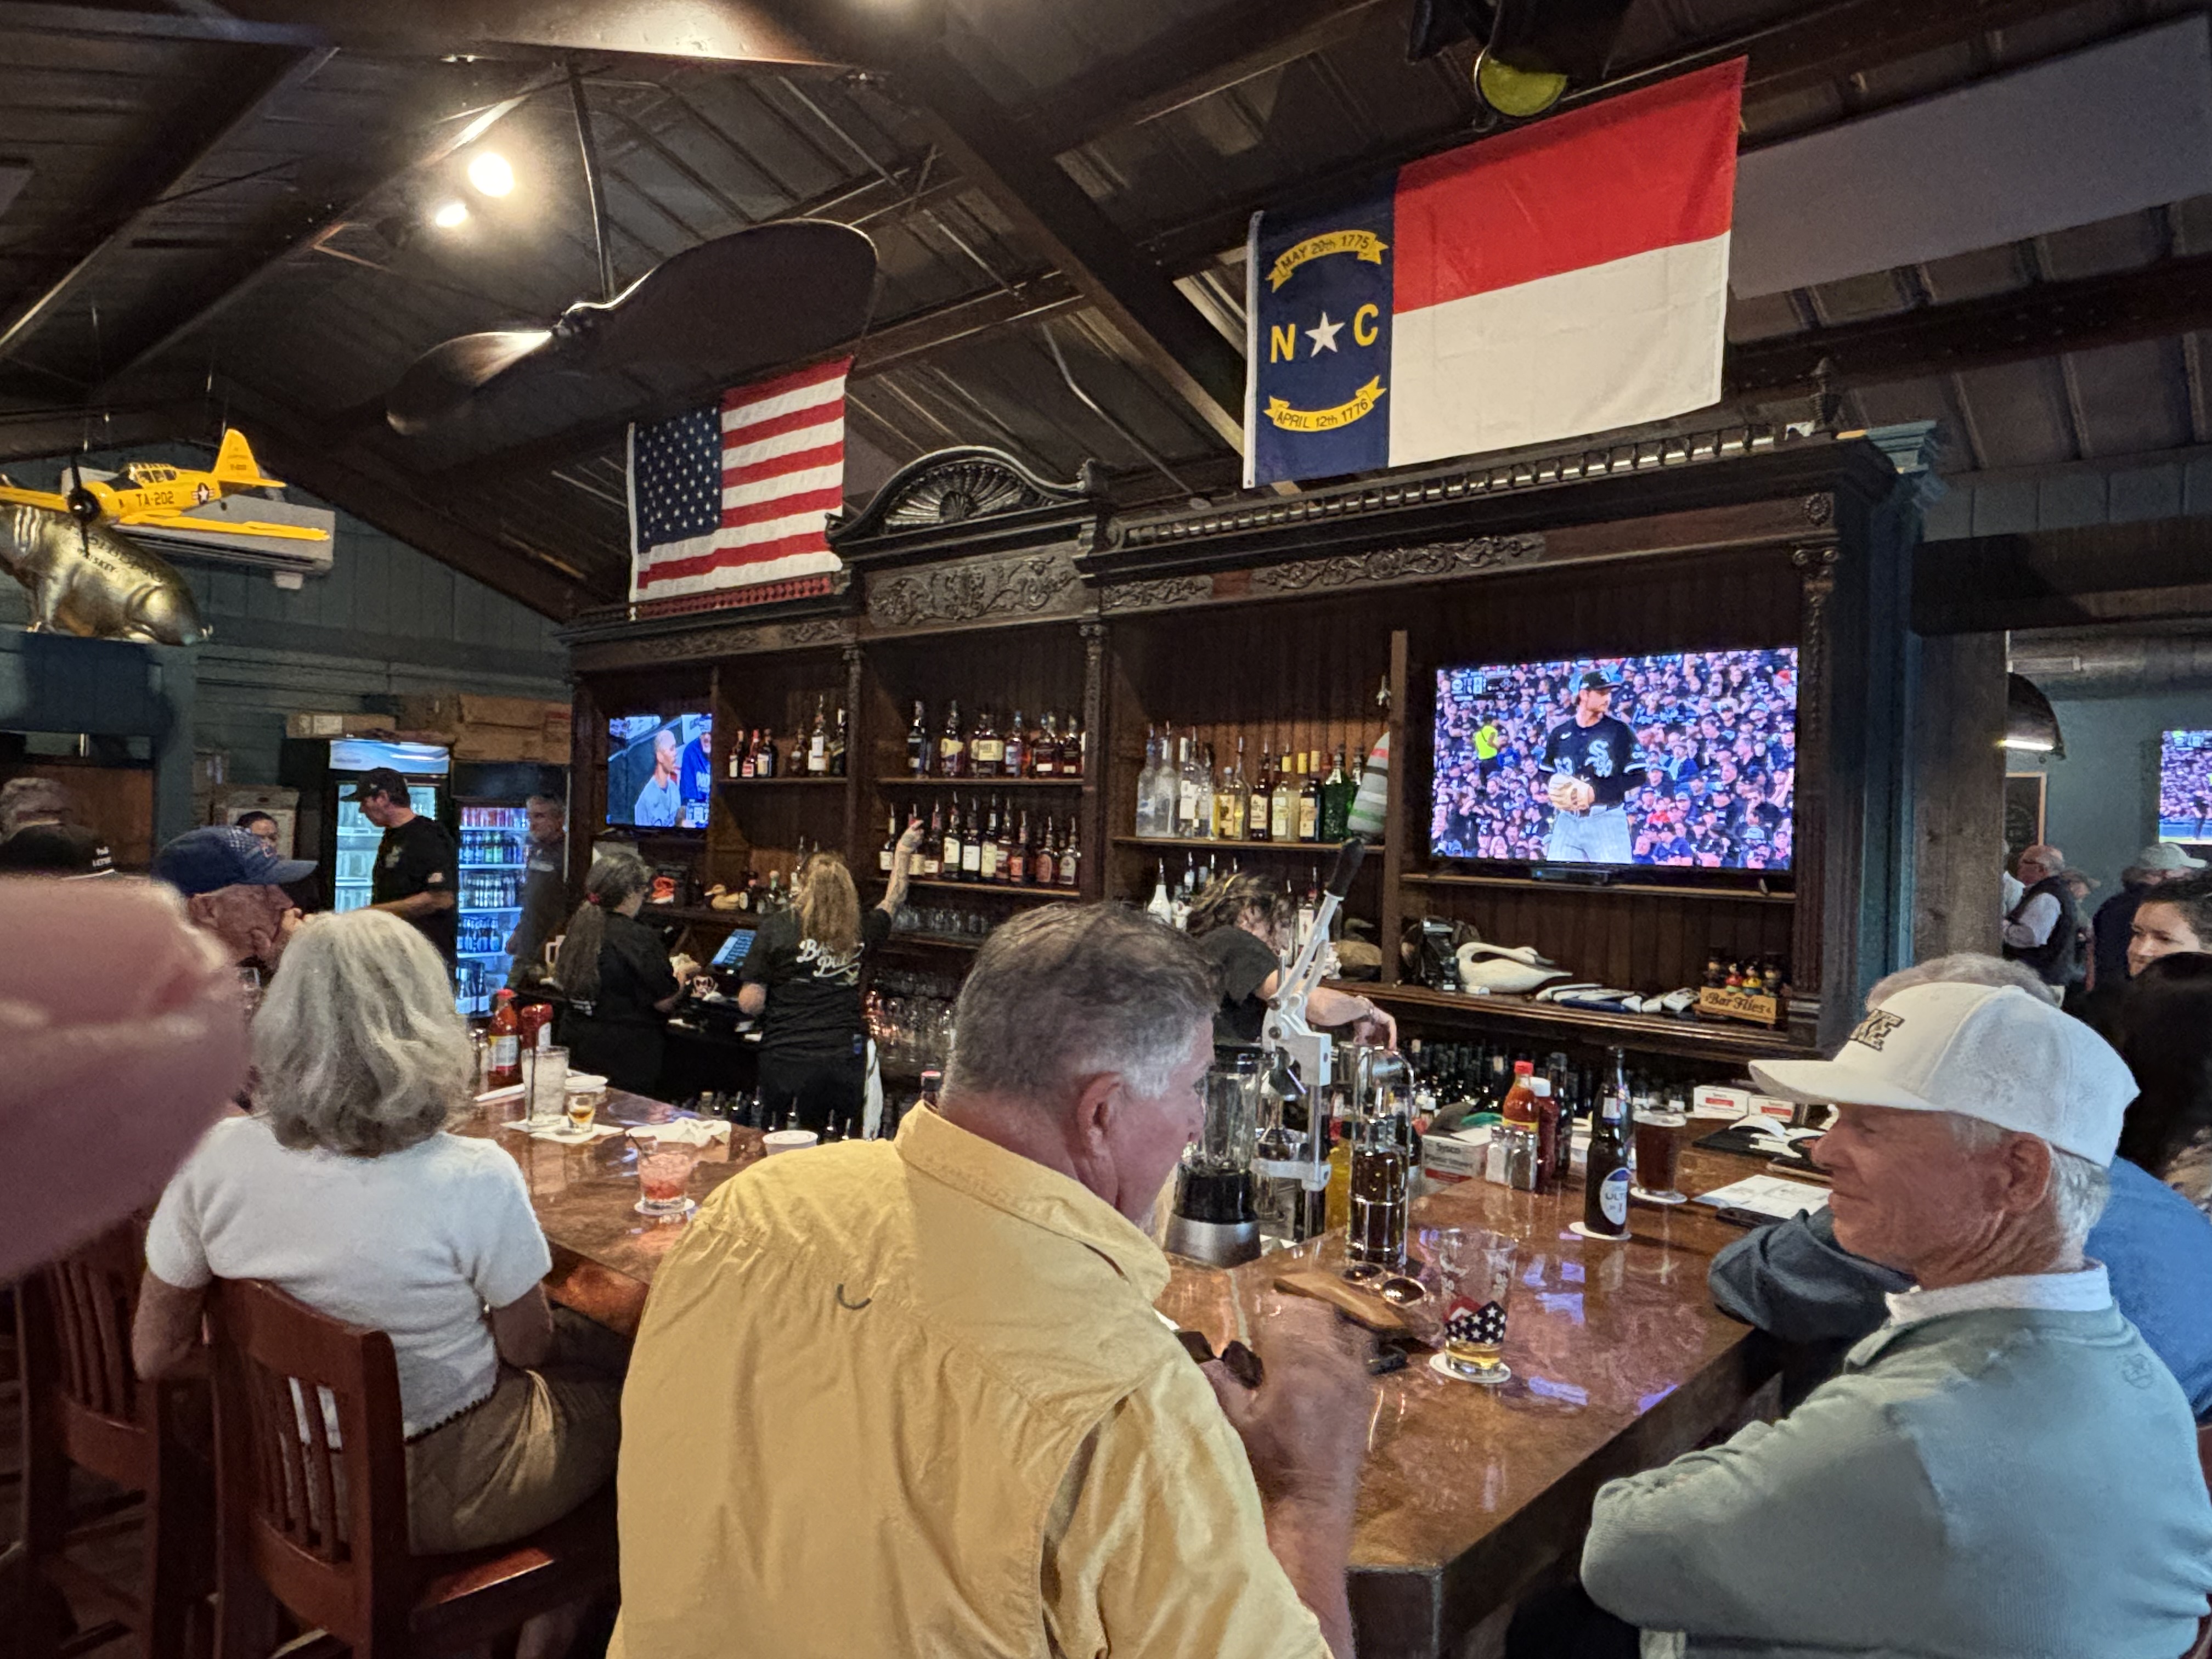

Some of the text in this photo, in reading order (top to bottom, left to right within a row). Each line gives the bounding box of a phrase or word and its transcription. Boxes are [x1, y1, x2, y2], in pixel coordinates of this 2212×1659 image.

[1281, 234, 1370, 269] MAY 20th 1775
[1270, 303, 1379, 363] N C
[1276, 398, 1369, 429] APRIL 12th 1776
[136, 490, 174, 507] TA-202
[1708, 992, 1765, 1014] Bar Flies
